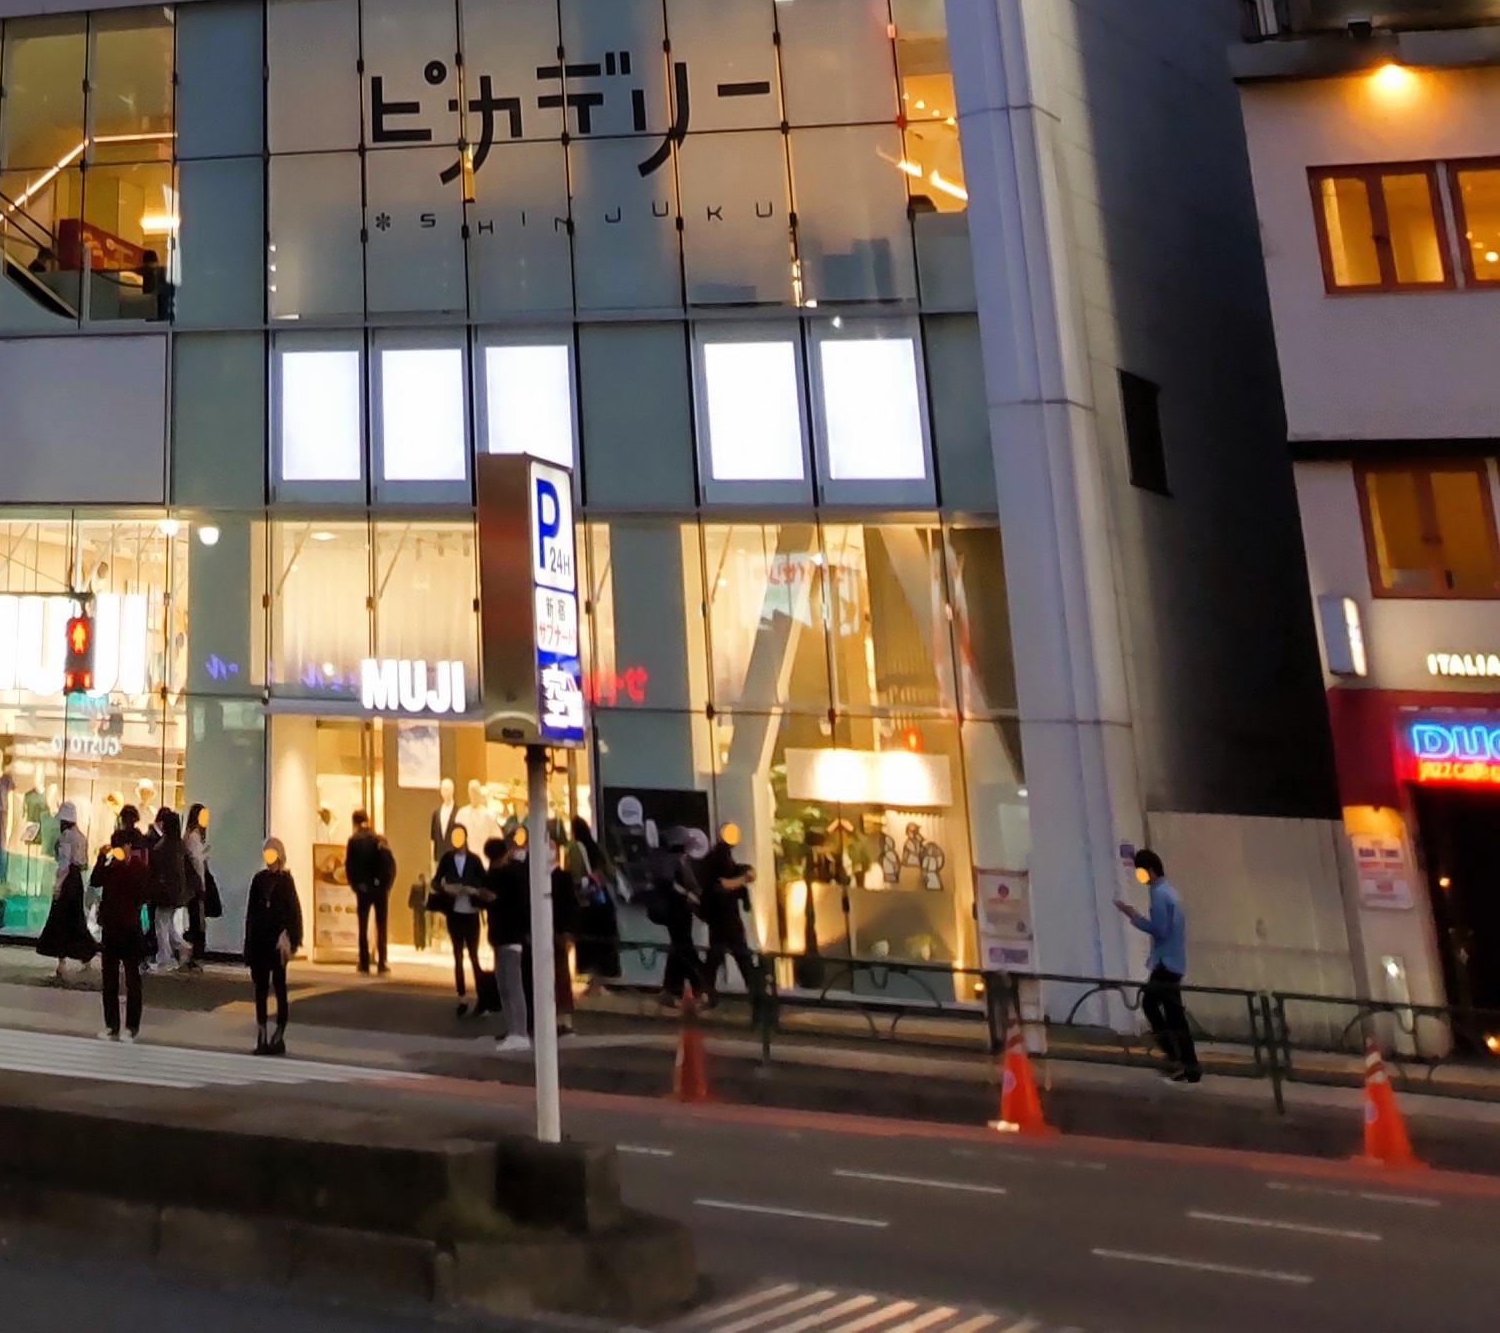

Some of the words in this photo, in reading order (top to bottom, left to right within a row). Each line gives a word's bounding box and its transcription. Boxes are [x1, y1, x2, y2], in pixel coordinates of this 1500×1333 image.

[371, 51, 771, 185] ピカデリー
[536, 477, 561, 569] P
[549, 546, 571, 576] 24H
[545, 597, 567, 622] 新宿
[360, 658, 466, 713] MUJI
